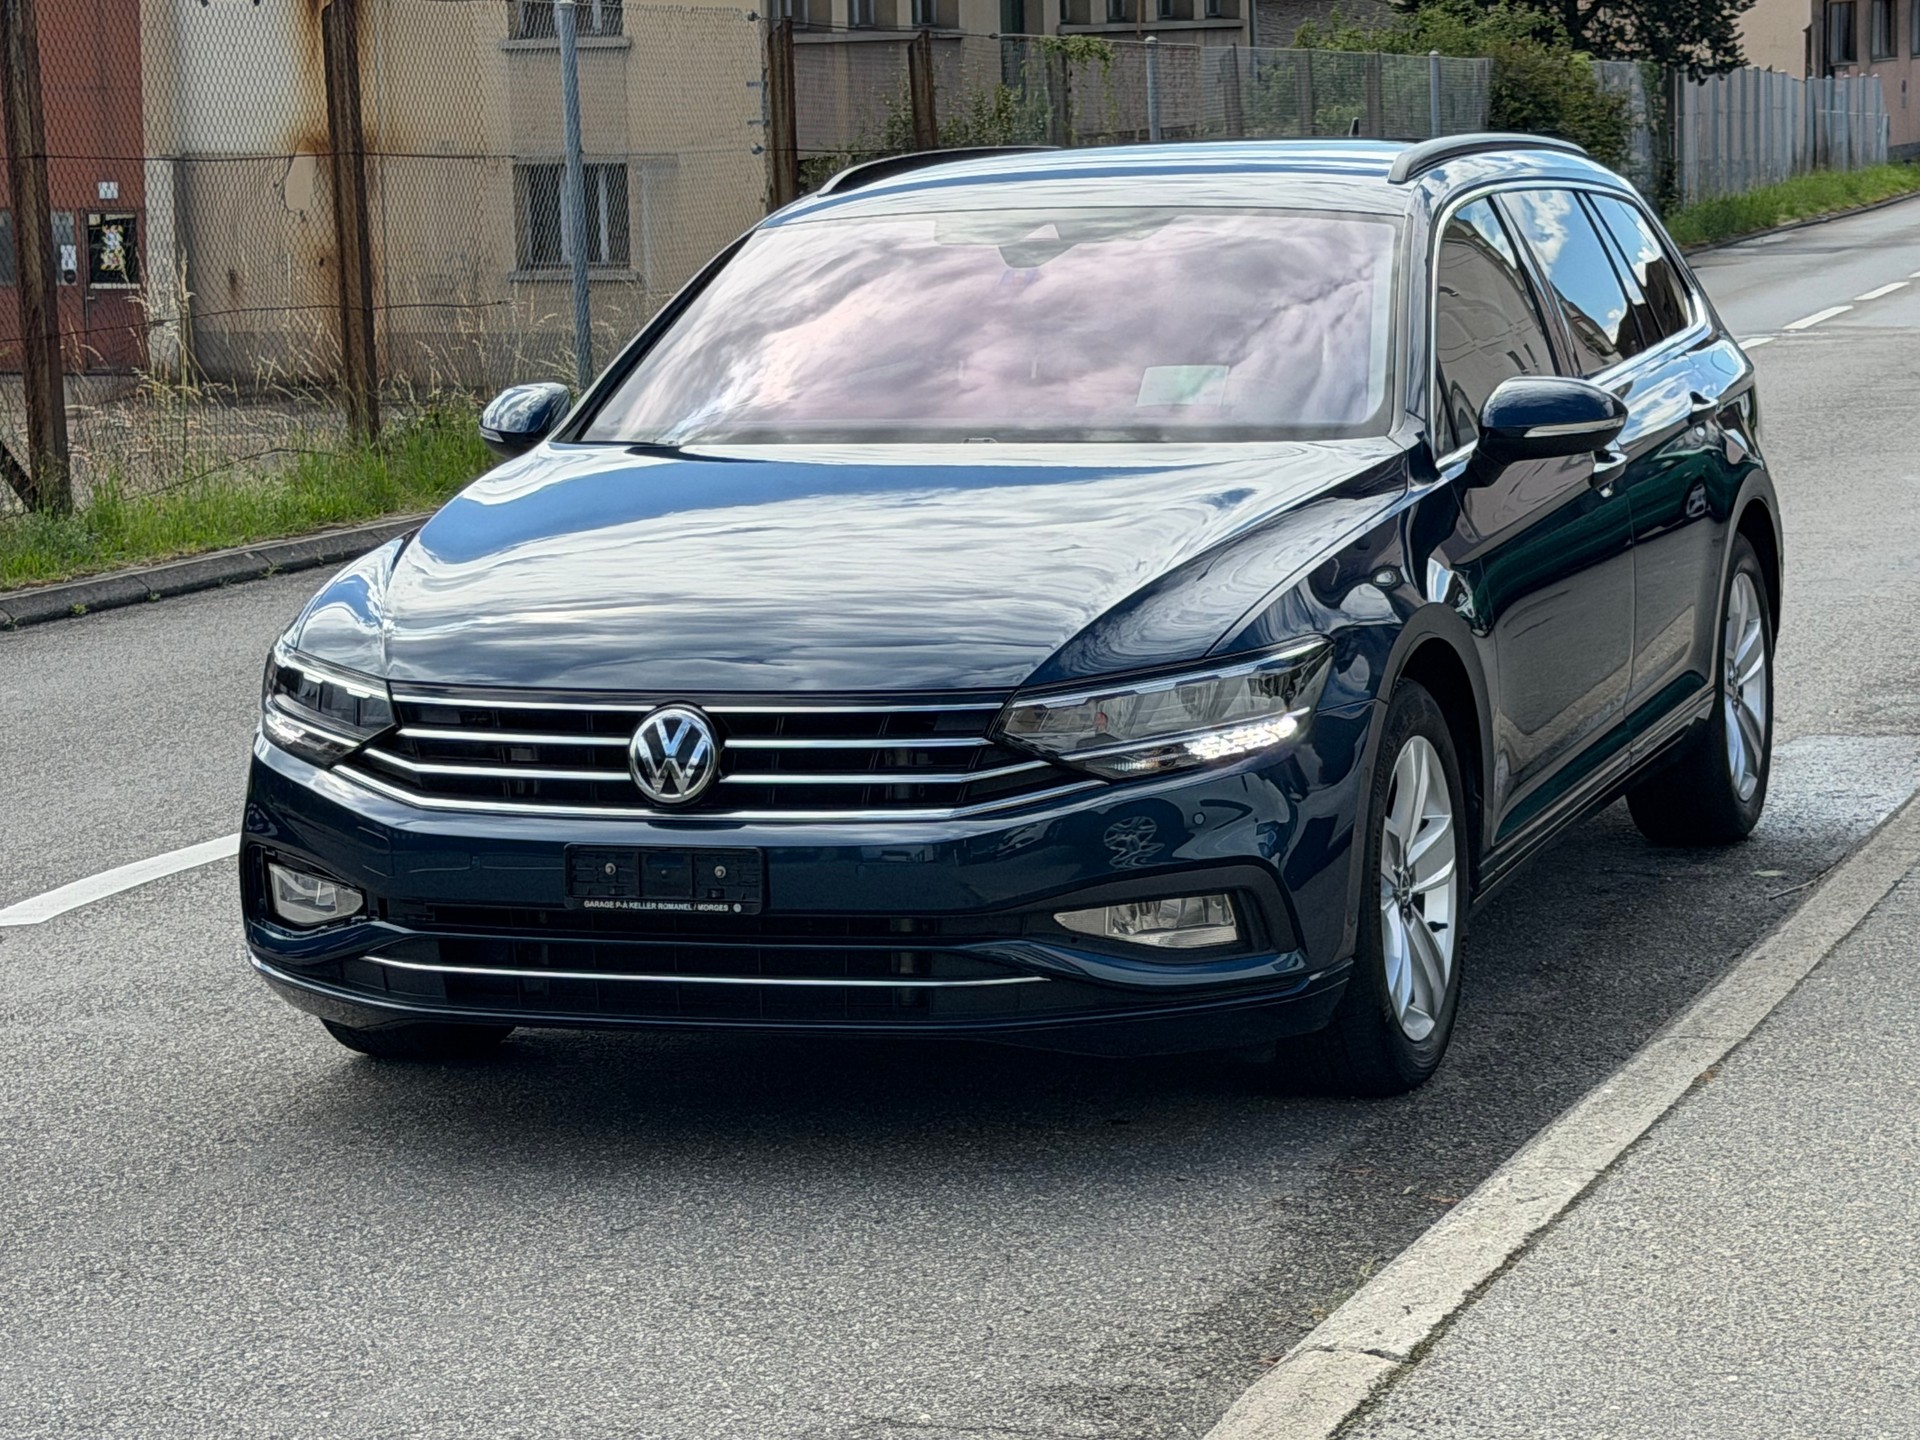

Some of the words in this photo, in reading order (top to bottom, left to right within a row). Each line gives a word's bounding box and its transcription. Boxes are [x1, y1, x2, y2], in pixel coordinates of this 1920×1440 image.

[635, 715, 711, 798] VW
[583, 900, 615, 909] GARAGE
[629, 901, 657, 910] KELLER
[658, 902, 693, 911] ROMANEL
[698, 903, 729, 912] MORGES
